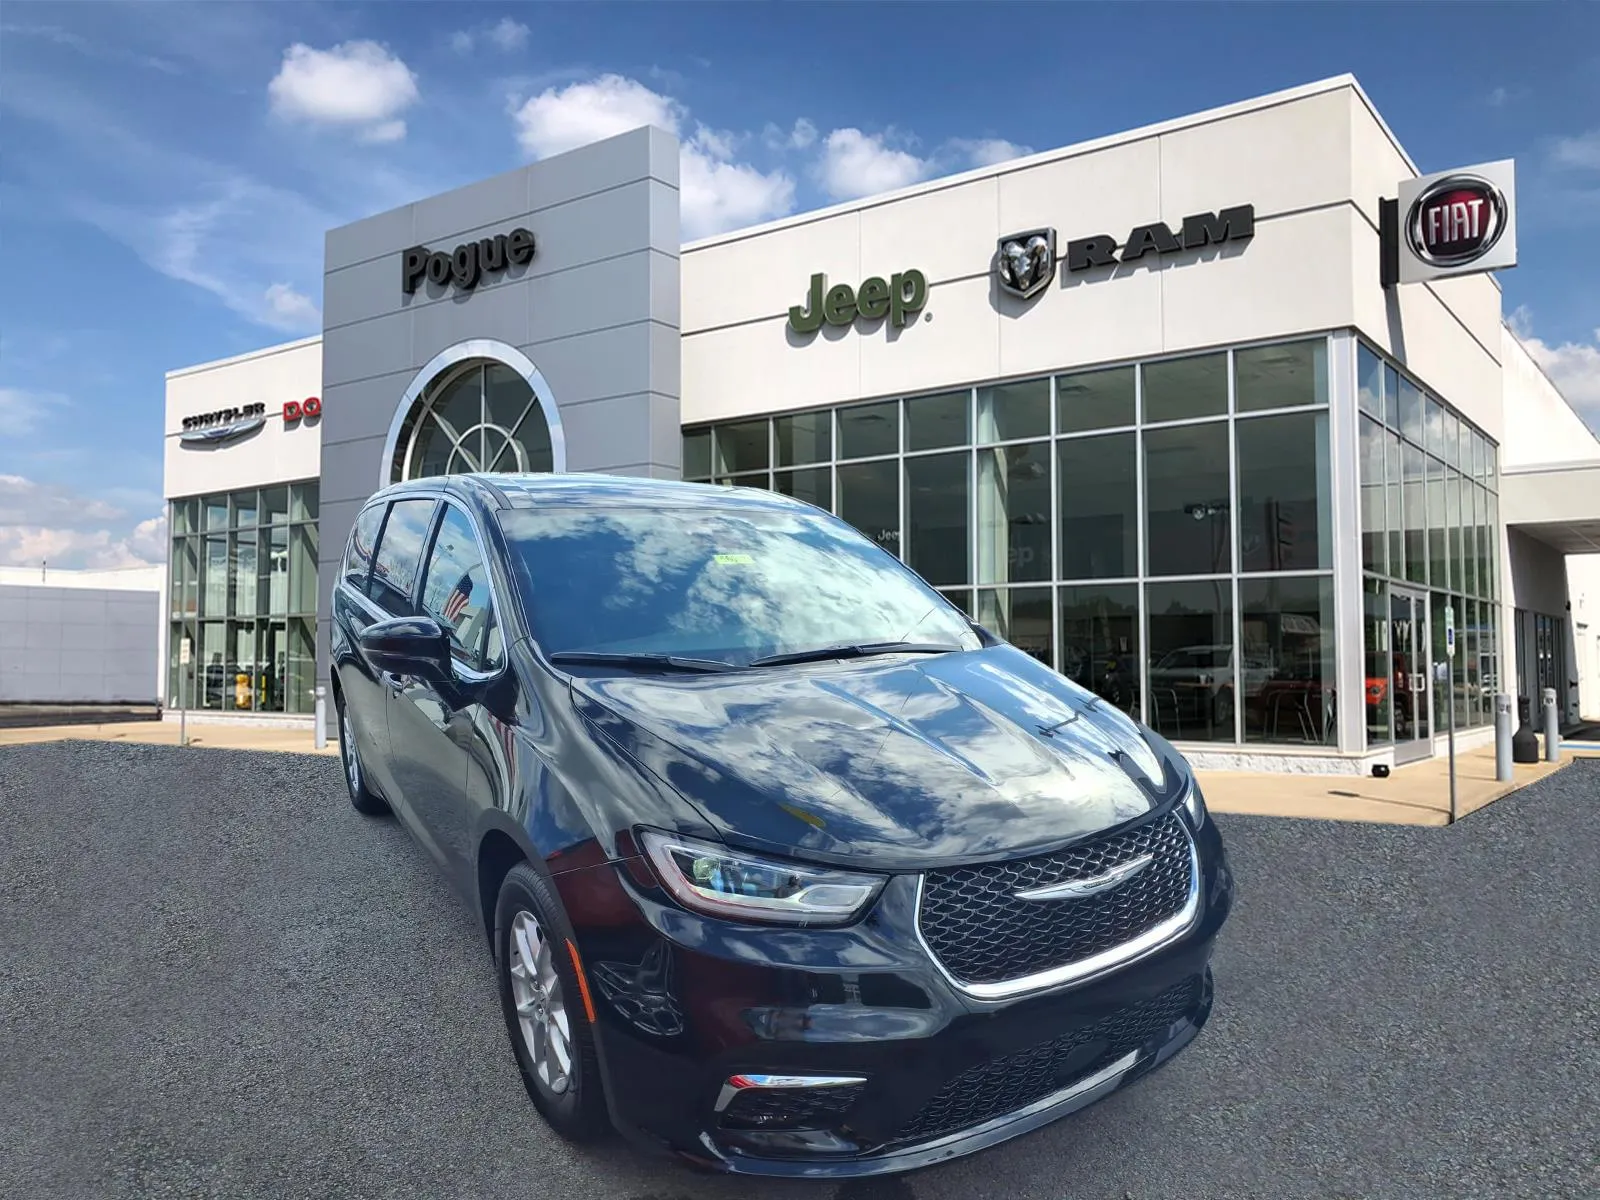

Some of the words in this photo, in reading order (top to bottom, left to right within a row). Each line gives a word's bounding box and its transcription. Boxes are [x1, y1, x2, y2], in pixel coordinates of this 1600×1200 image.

[1067, 203, 1254, 271] RAM
[1428, 199, 1483, 246] FIAT
[402, 227, 535, 294] Pogue
[788, 268, 927, 332] Jeep
